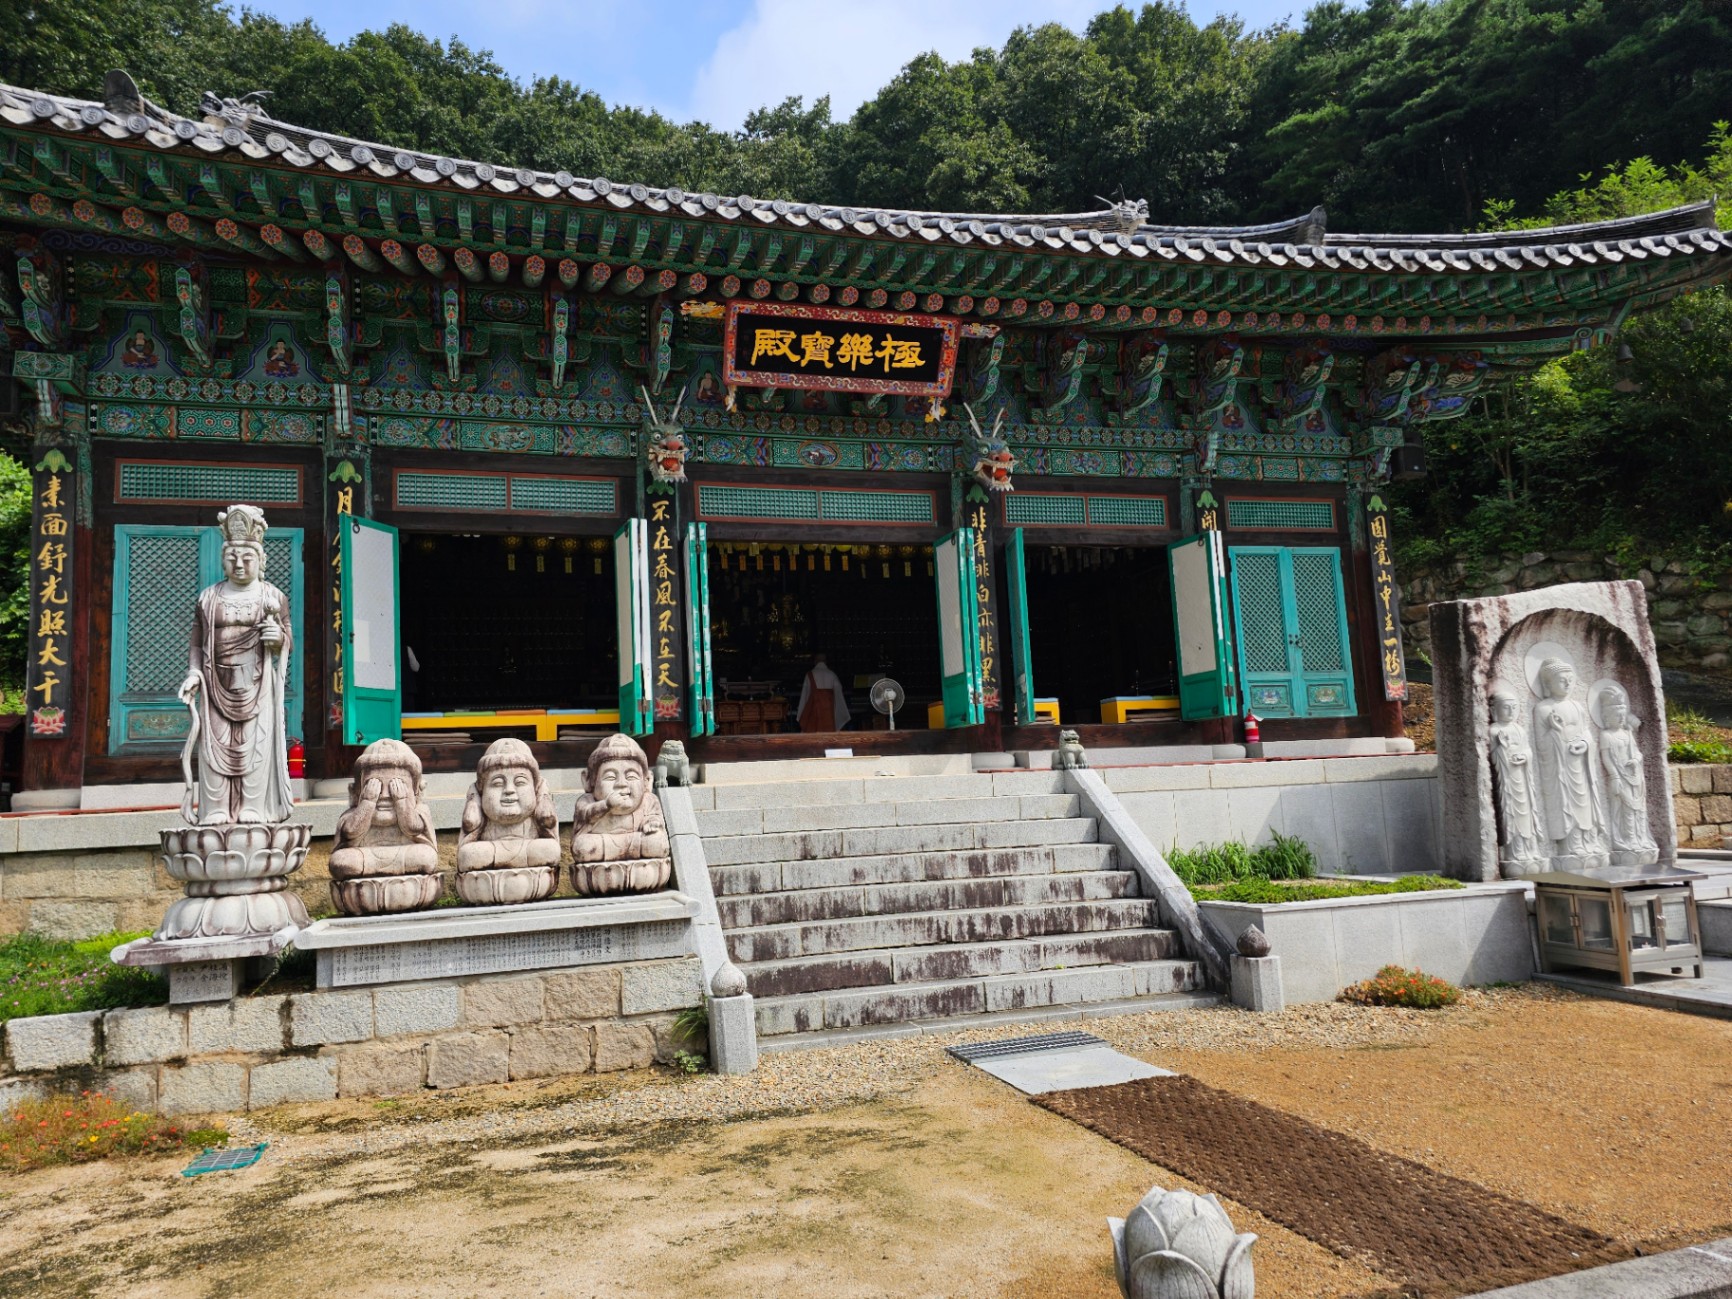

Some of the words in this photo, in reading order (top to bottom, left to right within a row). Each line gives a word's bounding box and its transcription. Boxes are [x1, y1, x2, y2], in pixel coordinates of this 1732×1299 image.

[651, 500, 679, 688] 不在春風不在天
[972, 506, 997, 682] 非青非白亦非黑
